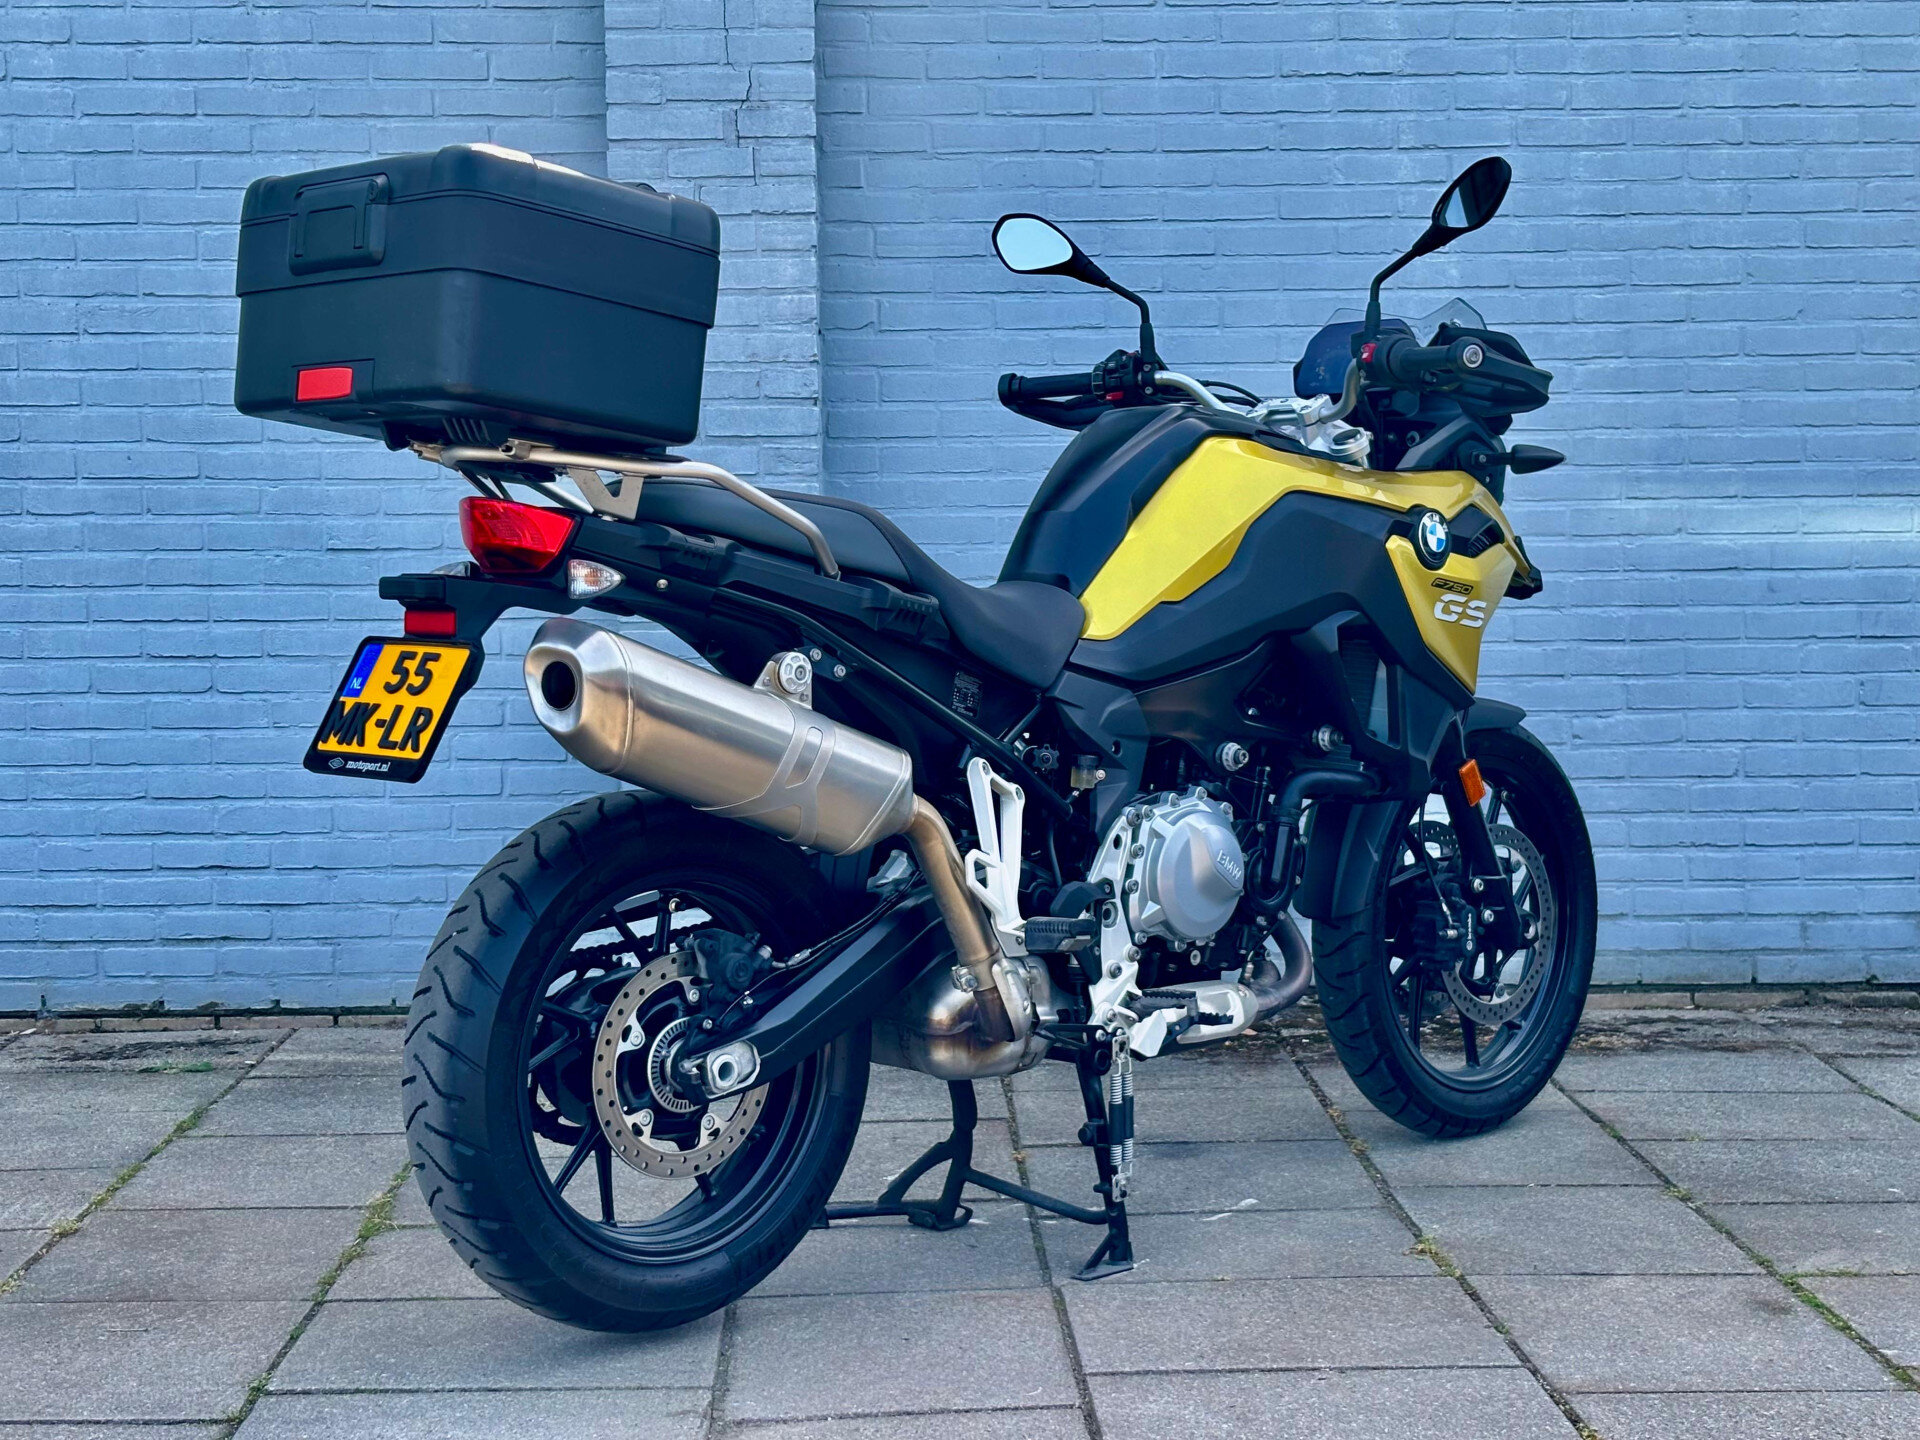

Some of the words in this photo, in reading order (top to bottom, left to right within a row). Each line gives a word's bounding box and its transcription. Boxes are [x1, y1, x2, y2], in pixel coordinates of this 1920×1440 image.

[1434, 593, 1487, 628] GS
[350, 677, 362, 690] NL
[383, 650, 441, 696] 55
[320, 700, 434, 753] MK-LR
[345, 760, 391, 773] motoport.nl
[1216, 849, 1242, 880] BMW
